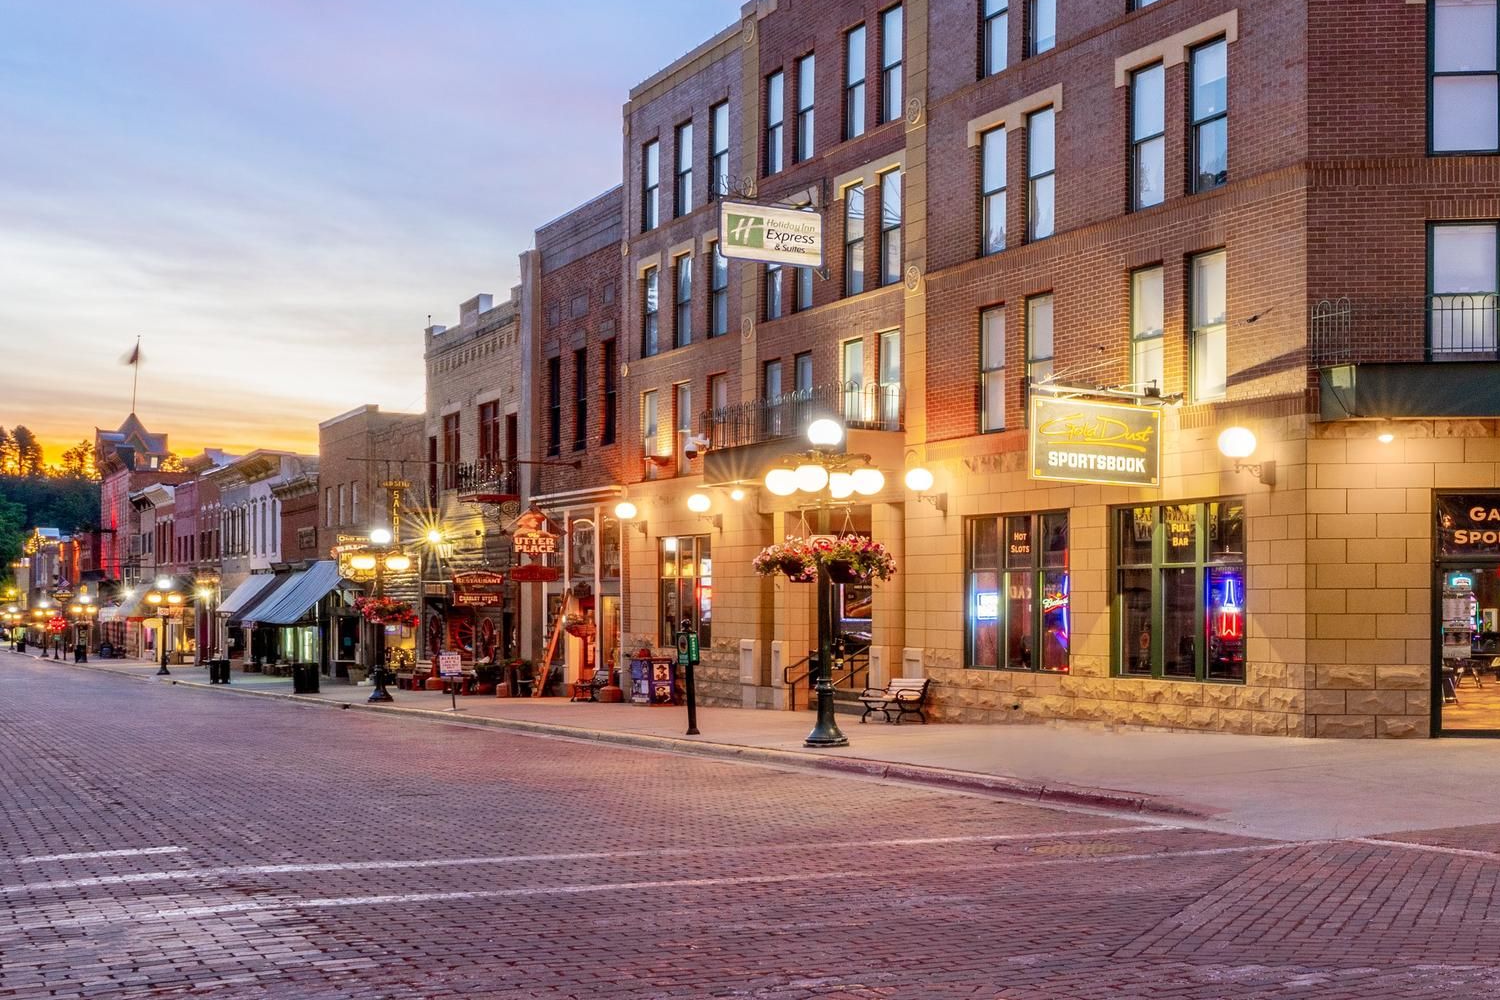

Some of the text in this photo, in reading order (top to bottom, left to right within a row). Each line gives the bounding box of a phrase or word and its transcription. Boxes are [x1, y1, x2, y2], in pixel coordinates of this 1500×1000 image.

[767, 219, 815, 233] Holiday Inn
[766, 229, 815, 244] Express
[782, 244, 806, 253] Suites
[1039, 413, 1154, 442] Gold Dust
[1048, 450, 1146, 473] SPORTSBOOK
[1171, 523, 1190, 533] FULL
[515, 537, 554, 545] UTTER
[1014, 533, 1027, 541] HOT
[1172, 537, 1189, 546] BAR
[515, 545, 555, 553] PLACE
[1010, 545, 1030, 553] SLOTS
